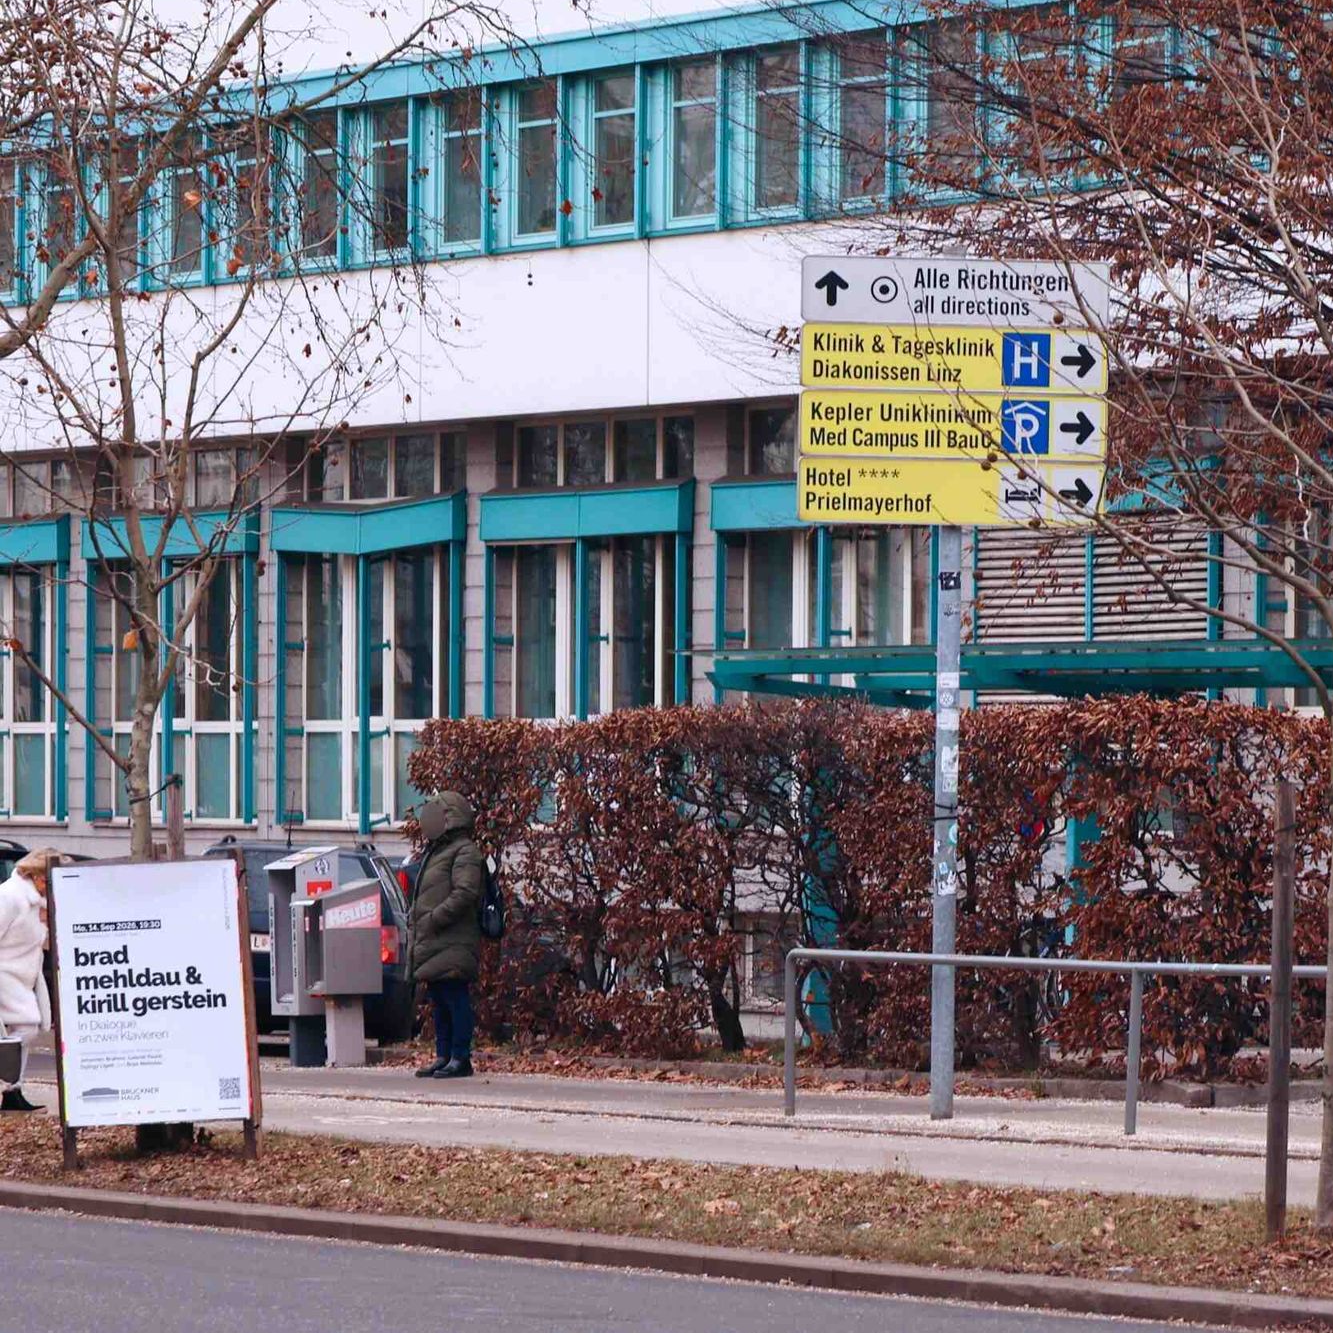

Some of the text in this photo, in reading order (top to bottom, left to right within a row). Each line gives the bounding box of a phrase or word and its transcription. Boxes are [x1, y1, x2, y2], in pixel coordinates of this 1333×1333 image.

[914, 268, 1069, 296] Alle Richtungen
[914, 296, 1030, 316] all directions
[813, 333, 994, 359] Klinik & Tagesklinik
[813, 359, 962, 382] Diakonissen Linz
[1013, 341, 1038, 379] H
[811, 402, 992, 425] Kepler Uniklinikum
[810, 428, 847, 446] Med
[852, 428, 919, 451] Campus
[924, 430, 940, 448] III
[806, 468, 851, 486] Hotel
[805, 491, 932, 516] Prielmayerhof
[327, 901, 377, 924] Heute
[74, 945, 129, 966] brad
[76, 966, 203, 990] mehldau &
[77, 989, 227, 1017] kirill gerstein
